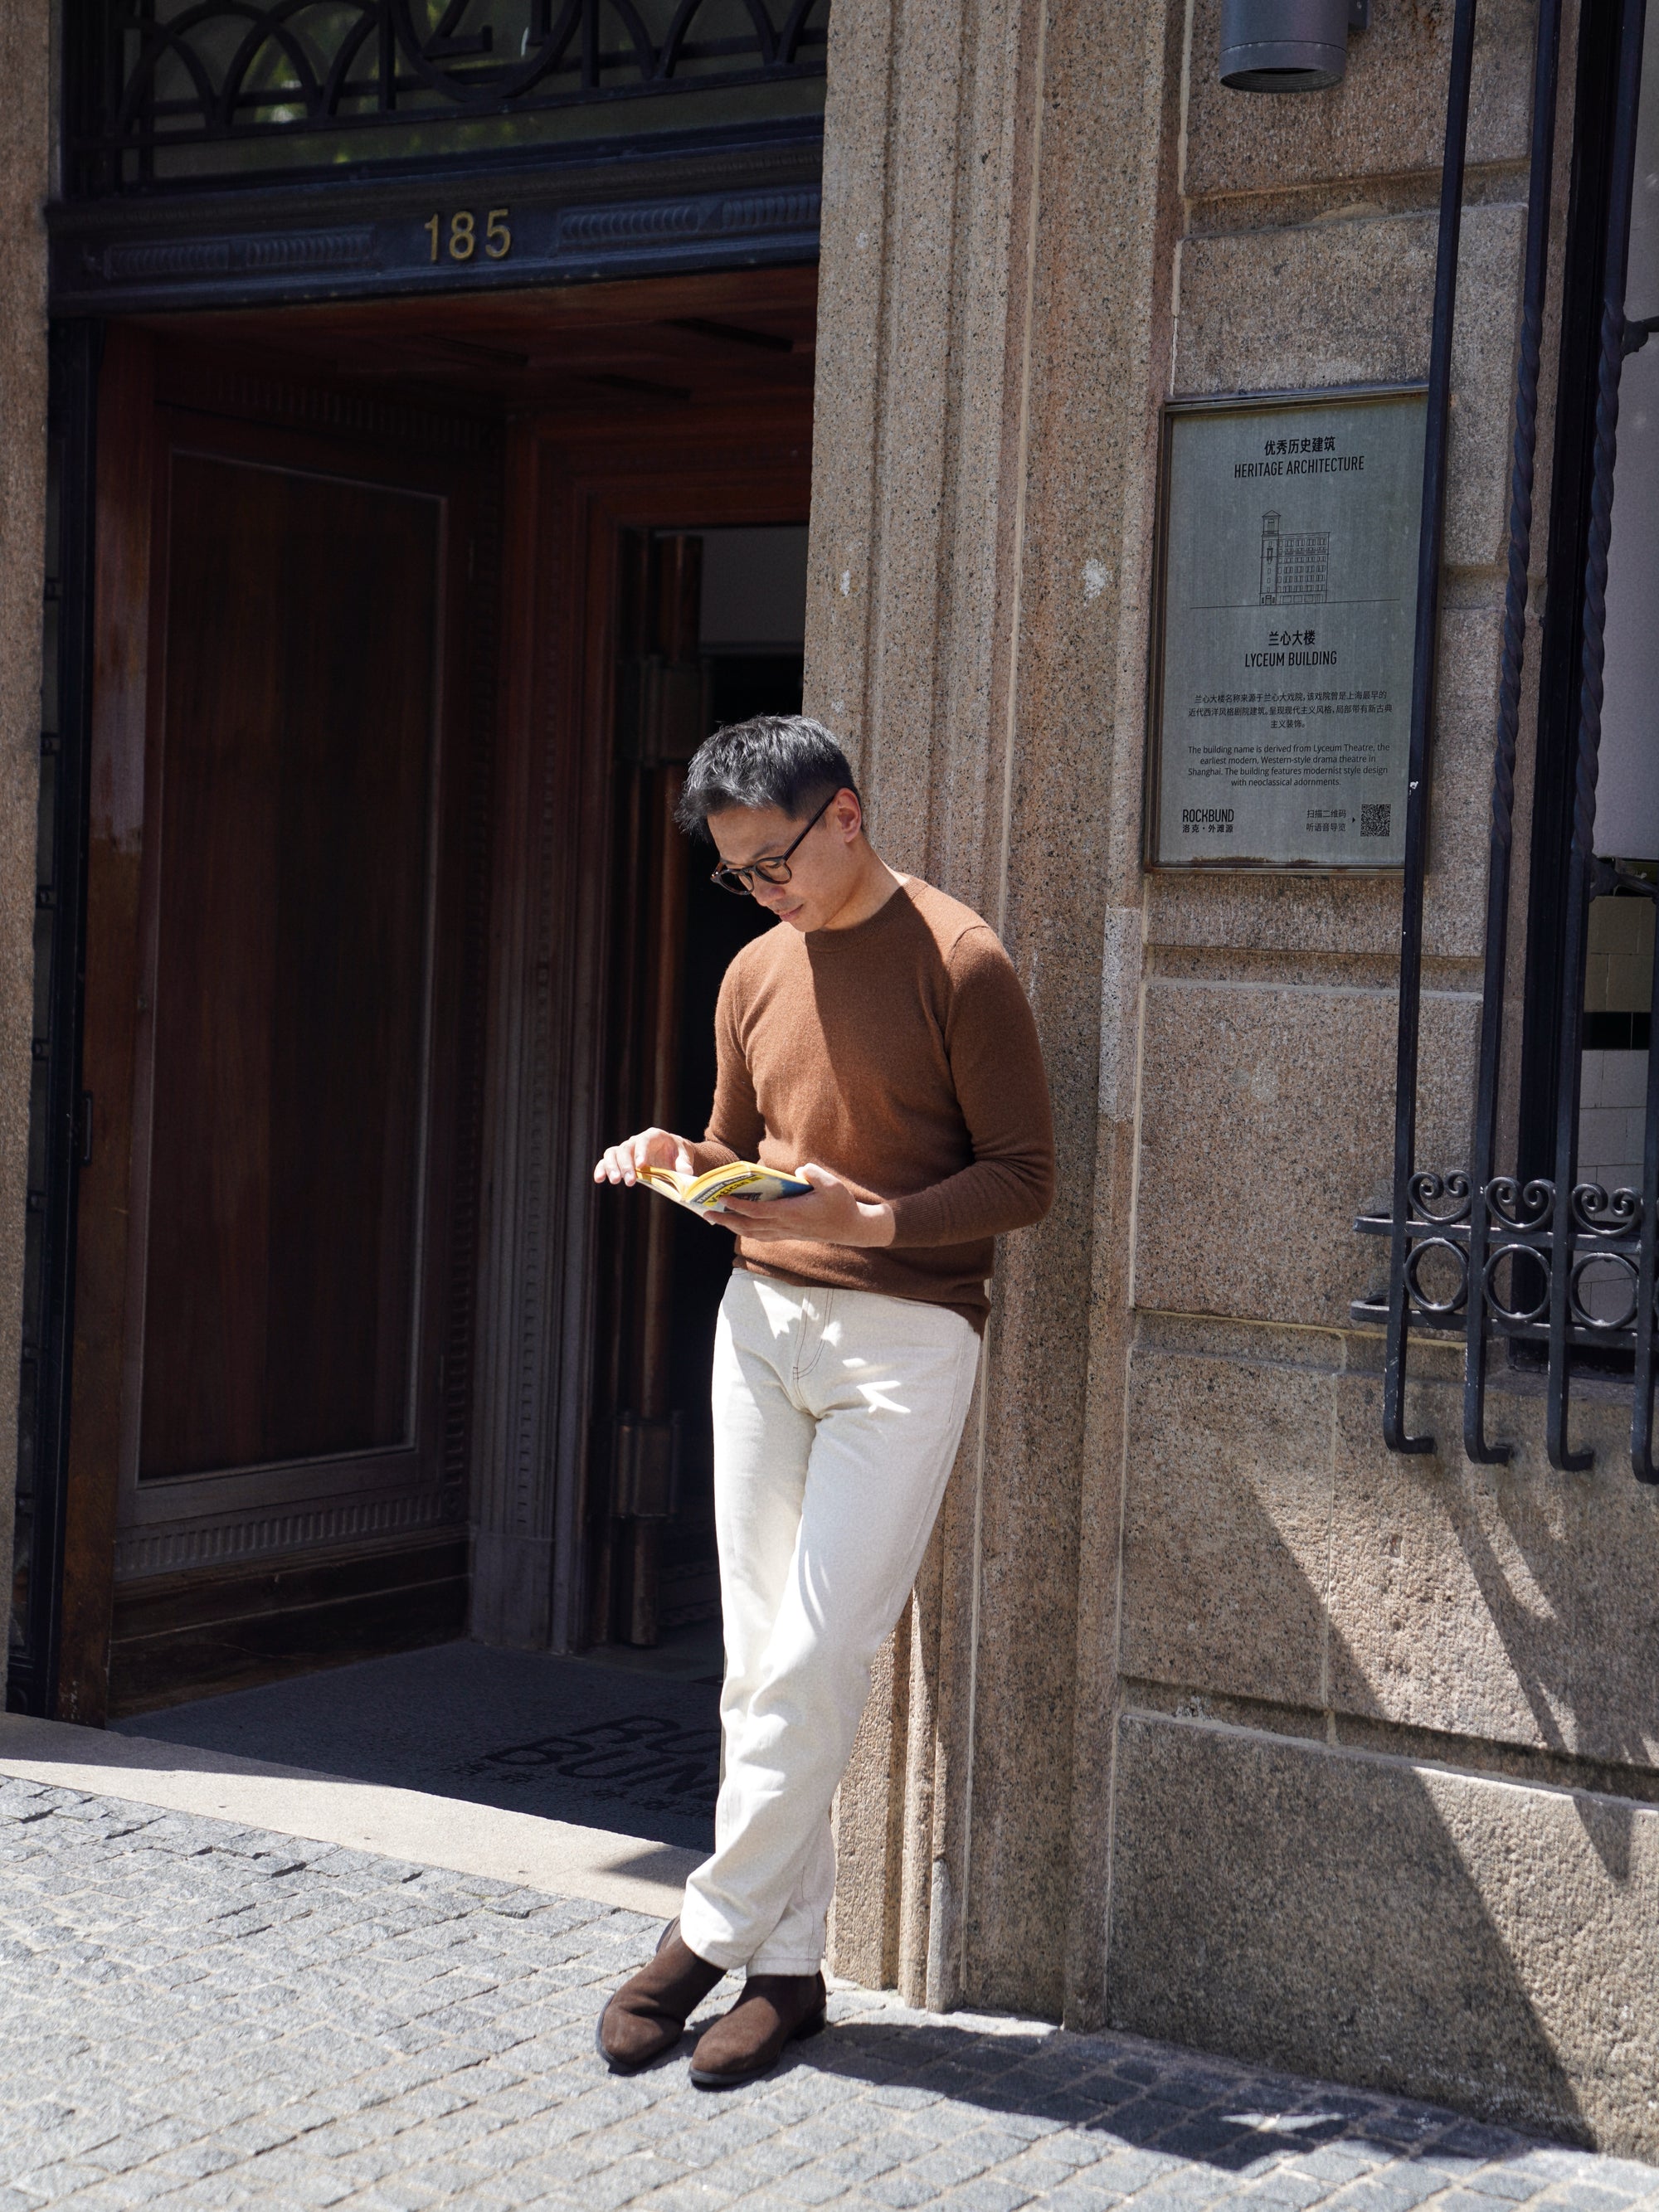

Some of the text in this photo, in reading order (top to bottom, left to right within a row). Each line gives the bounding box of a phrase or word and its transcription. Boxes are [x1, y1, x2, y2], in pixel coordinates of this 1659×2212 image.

[424, 208, 511, 262] 185
[1263, 435, 1336, 456] 优秀历史建筑
[1233, 455, 1365, 479] HERITAGE ARCHITECTURE
[1267, 630, 1316, 646] 兰心大楼
[1244, 650, 1338, 668] LYCEUM BUILDING
[1188, 746, 1202, 754] The
[1203, 745, 1232, 756] building
[1256, 745, 1262, 753] is
[1263, 744, 1292, 753] derived
[1293, 744, 1311, 753] from
[1313, 744, 1342, 754] Lyceum
[1344, 743, 1375, 752] Theatre,
[1377, 743, 1390, 751] the
[1199, 754, 1376, 766] earliest modern, Western-style drama theatre in
[1188, 765, 1389, 777] Shanghai. The building features modernist style design
[1231, 777, 1341, 786] with neoclassical adornments.
[1182, 809, 1234, 823] ROCKBUND
[1306, 809, 1347, 819] 扫描二维码
[1306, 822, 1346, 832] 听语音导览
